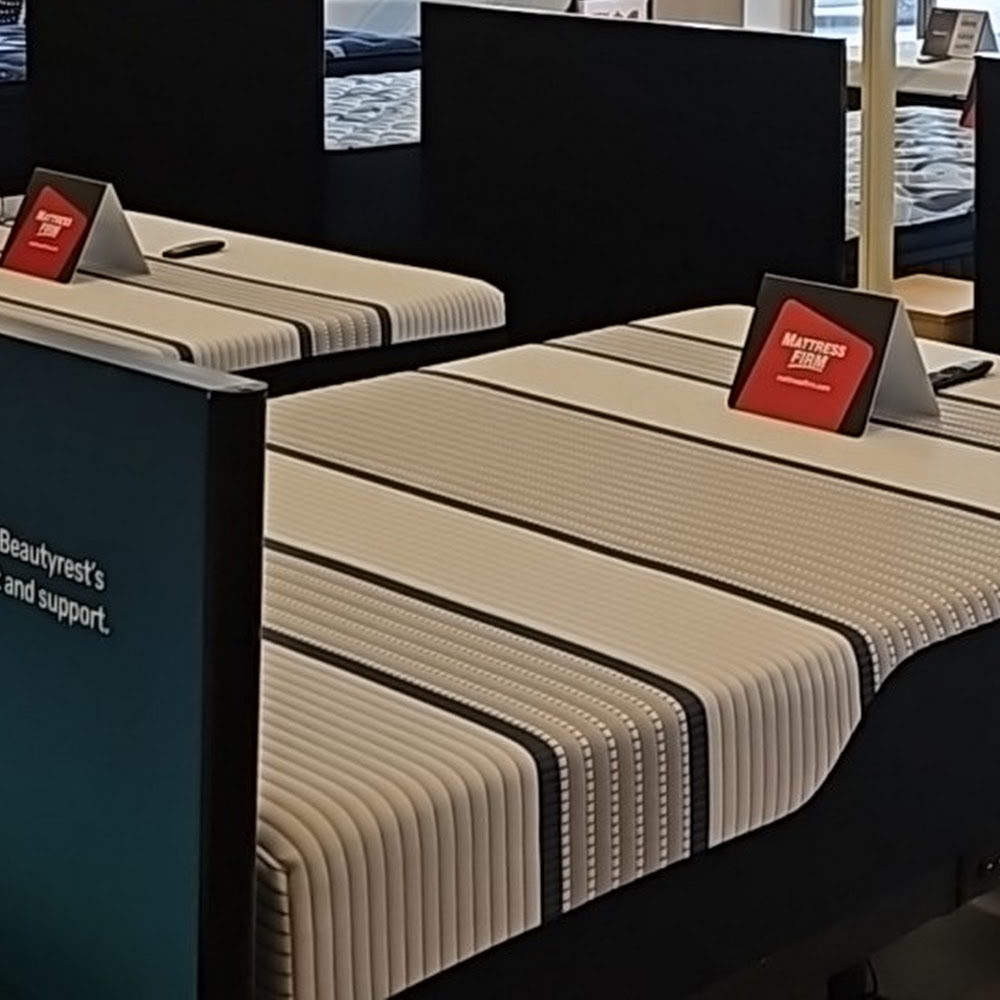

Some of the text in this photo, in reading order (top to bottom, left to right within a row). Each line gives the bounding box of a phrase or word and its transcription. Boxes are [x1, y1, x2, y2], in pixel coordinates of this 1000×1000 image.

[780, 331, 848, 359] MATTRESS
[788, 349, 830, 372] FIRM
[0, 527, 105, 591] Beautyrest's
[4, 575, 36, 604] and
[38, 587, 110, 636] support.
